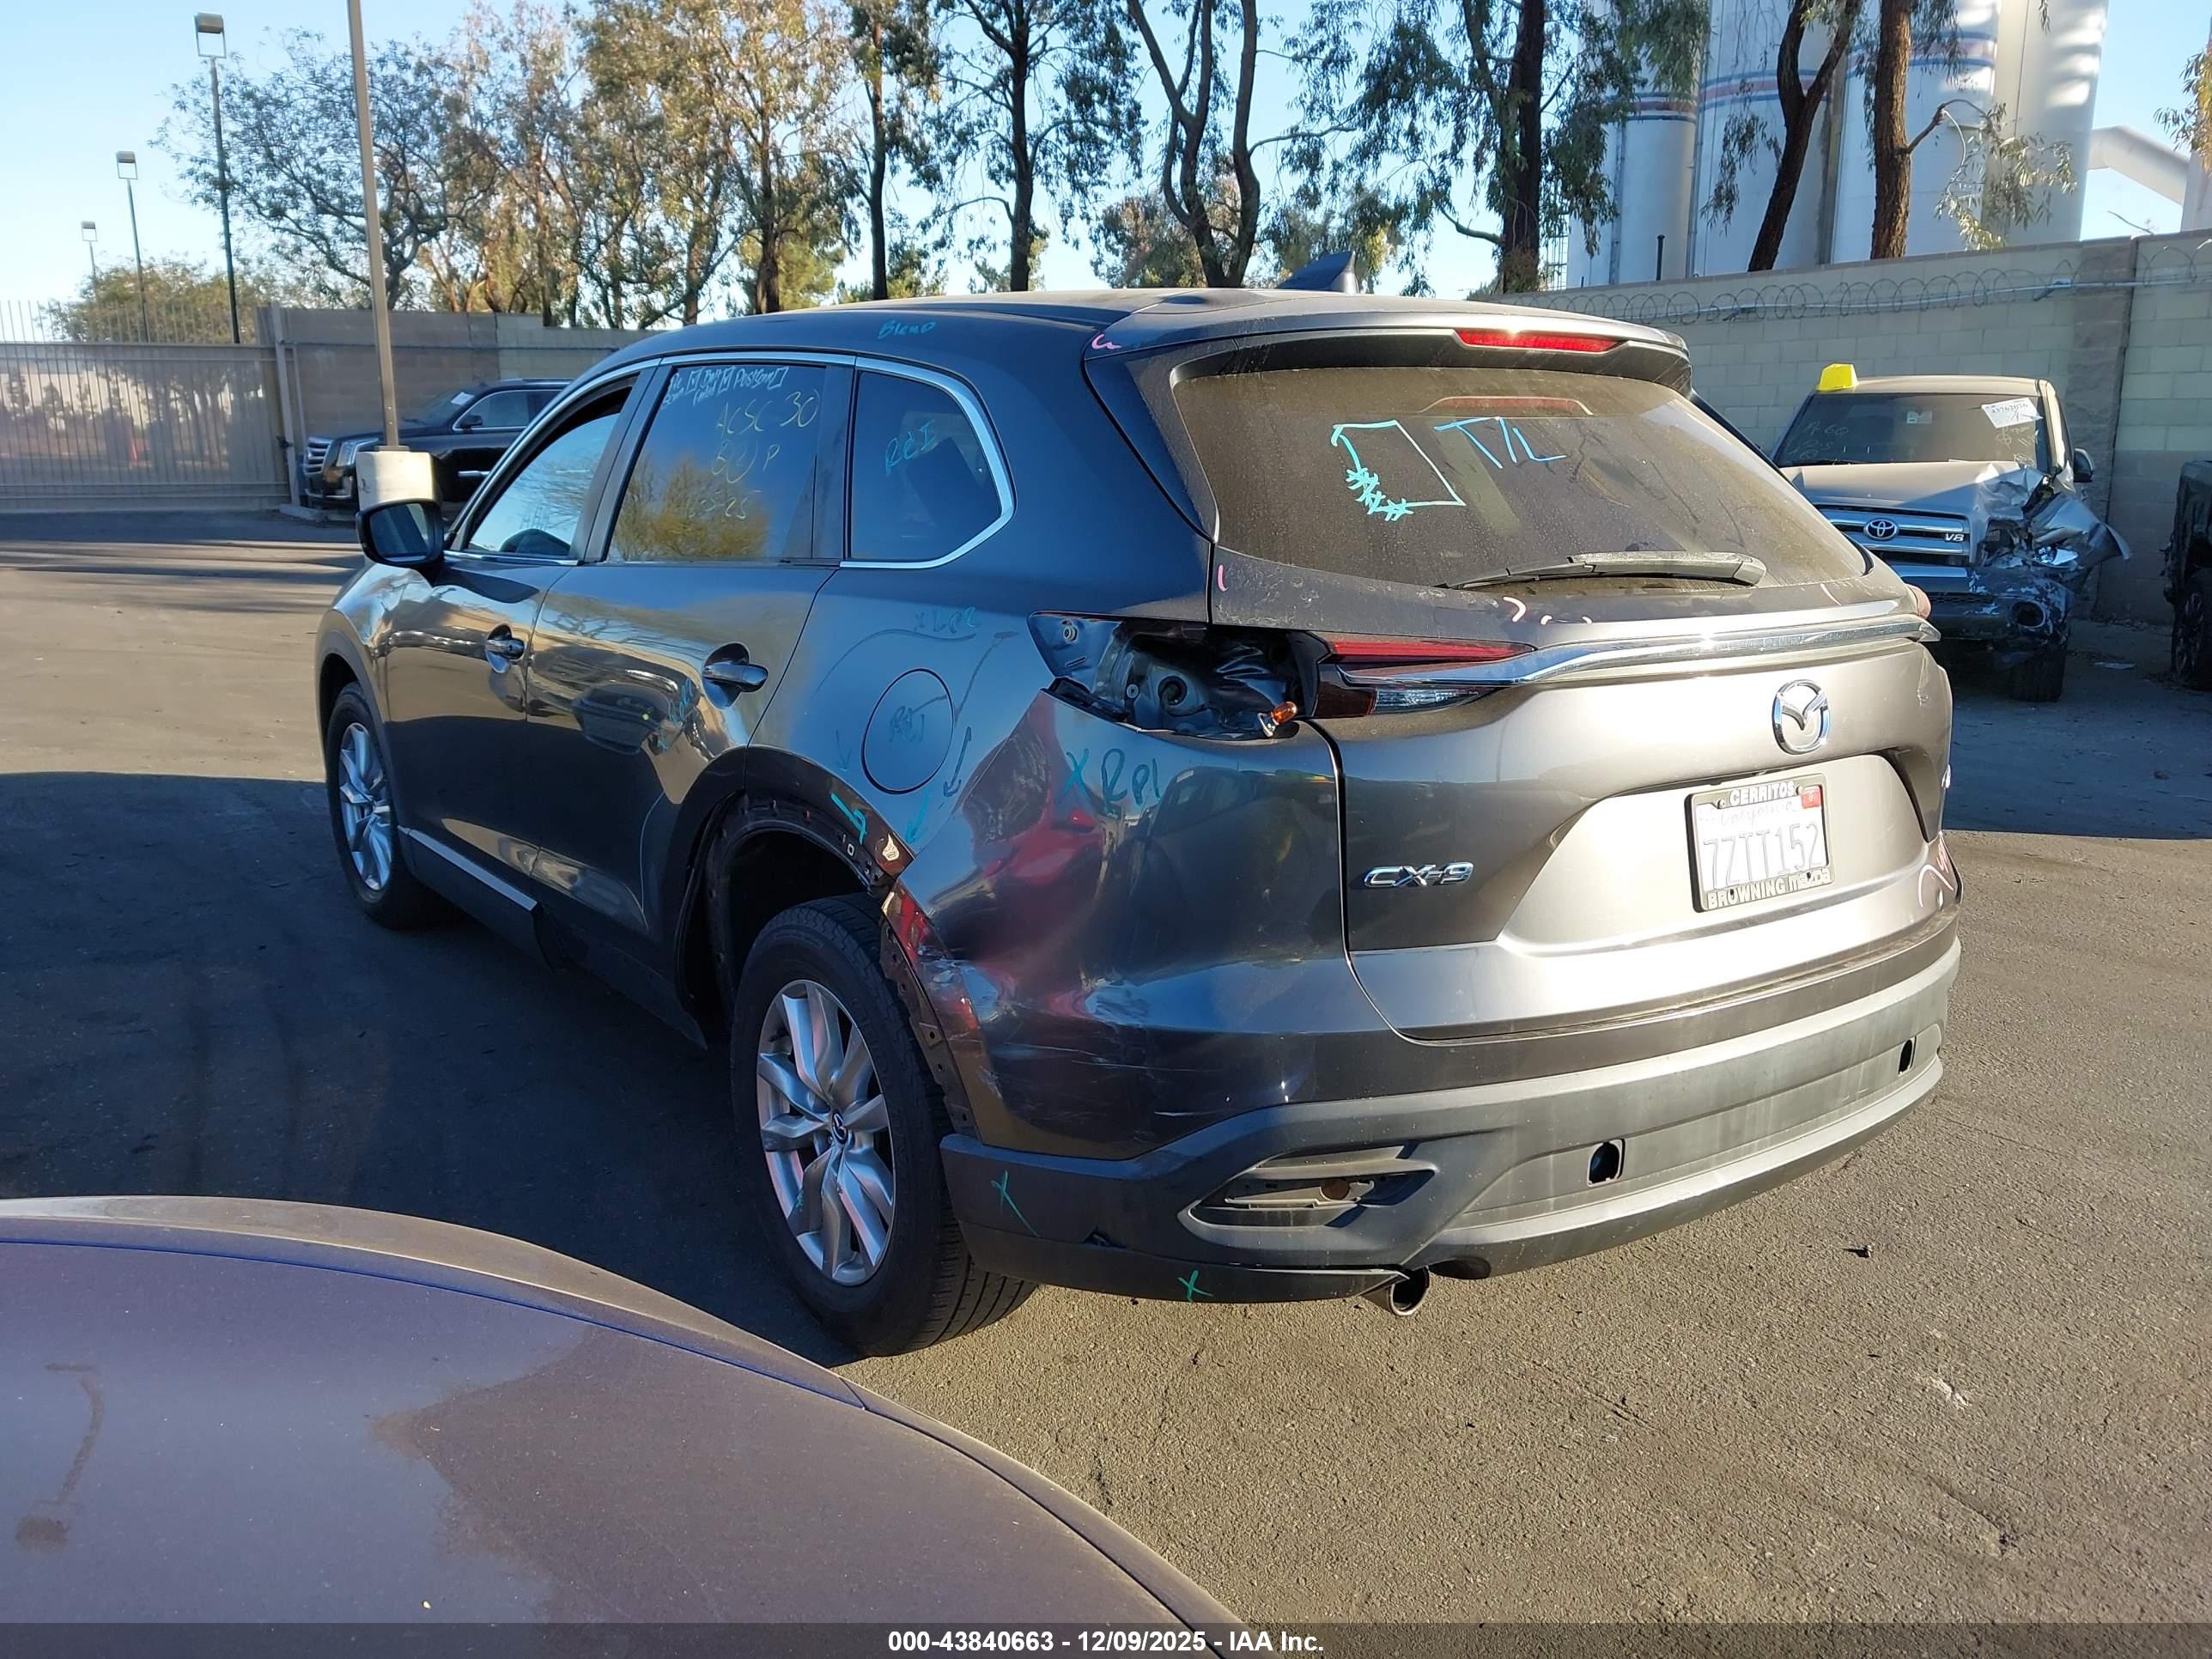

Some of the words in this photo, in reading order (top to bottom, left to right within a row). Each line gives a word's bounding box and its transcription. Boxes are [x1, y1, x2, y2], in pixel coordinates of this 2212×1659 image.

[1945, 532, 1965, 542] V8
[1729, 781, 1795, 805] CERRITOS
[1364, 861, 1474, 888] CX-9
[1707, 878, 1786, 909] BROWNING
